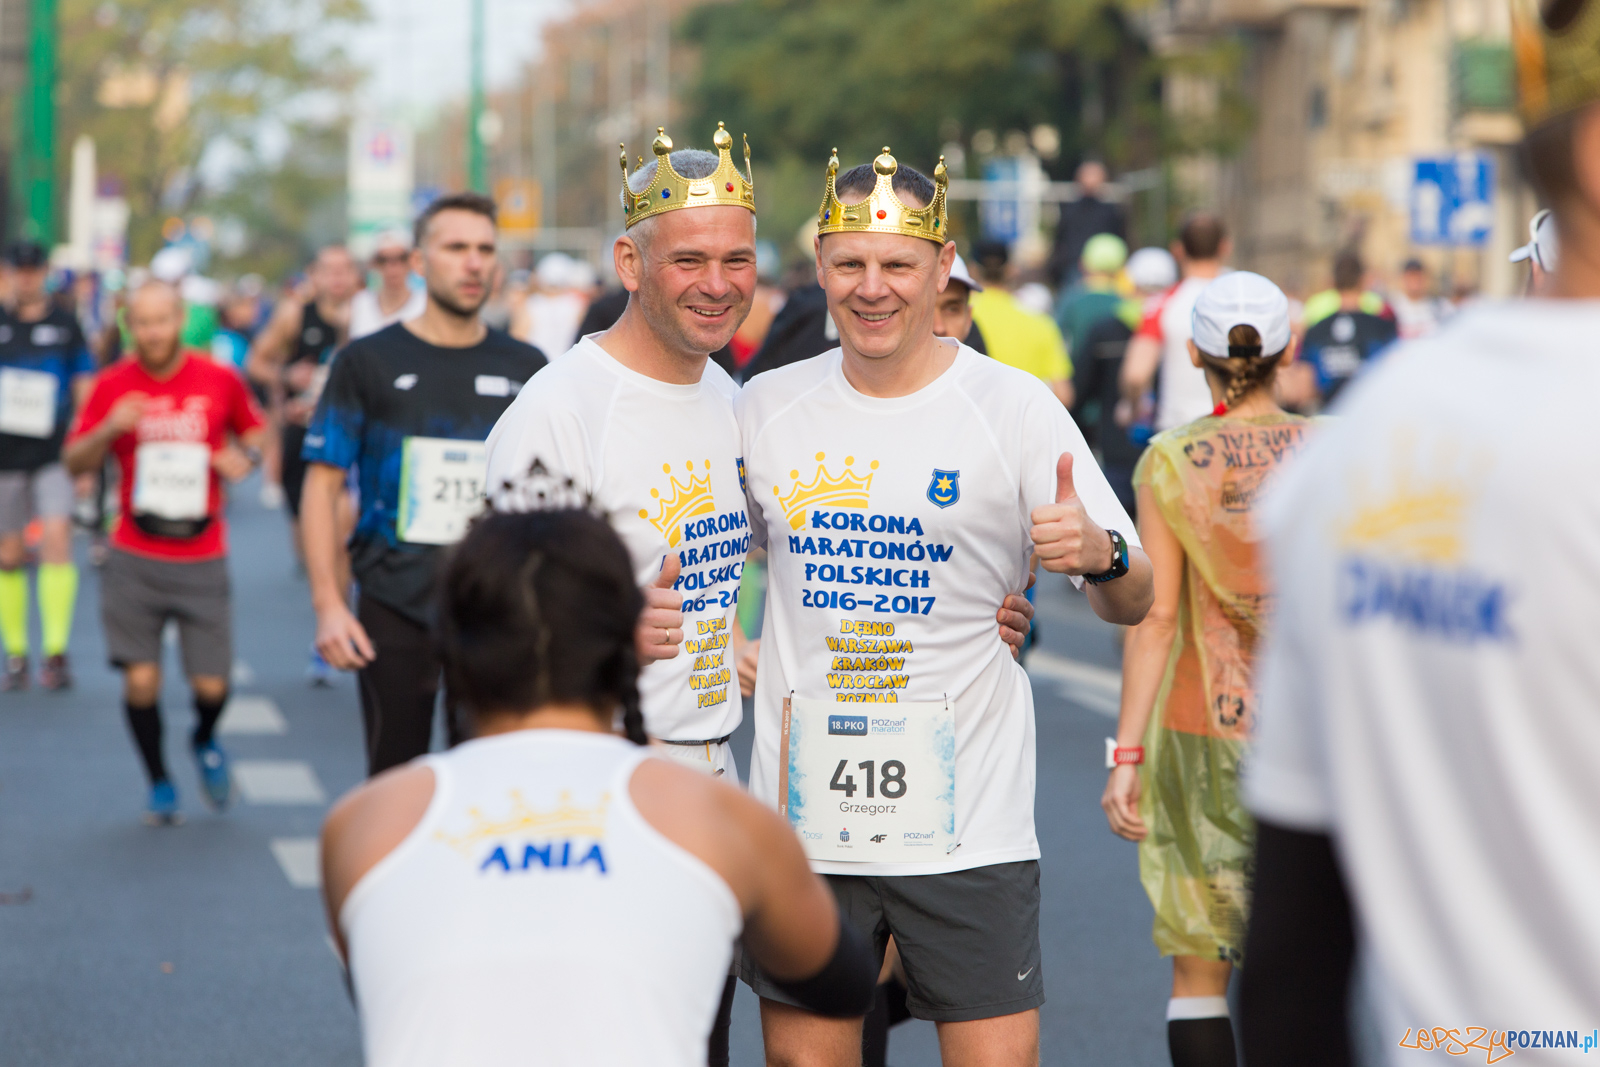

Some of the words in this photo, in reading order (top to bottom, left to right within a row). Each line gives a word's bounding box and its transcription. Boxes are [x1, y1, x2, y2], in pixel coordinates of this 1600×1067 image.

[1218, 429, 1291, 450] METAL
[685, 510, 748, 542] KORONA
[811, 511, 924, 536] KORONA
[788, 535, 954, 562] MARATONÓW
[805, 563, 931, 588] POLSKICH
[840, 619, 895, 638] DĘBNO
[825, 636, 914, 653] WARSZAWA
[831, 655, 905, 671] KRAKÓW
[826, 673, 909, 689] WROCŁAW
[832, 721, 844, 730] 18.
[844, 721, 865, 731] PKO
[830, 759, 907, 799] 418
[839, 801, 897, 816] Grzegorz
[870, 834, 888, 843] 4F
[480, 840, 607, 874] ANIA
